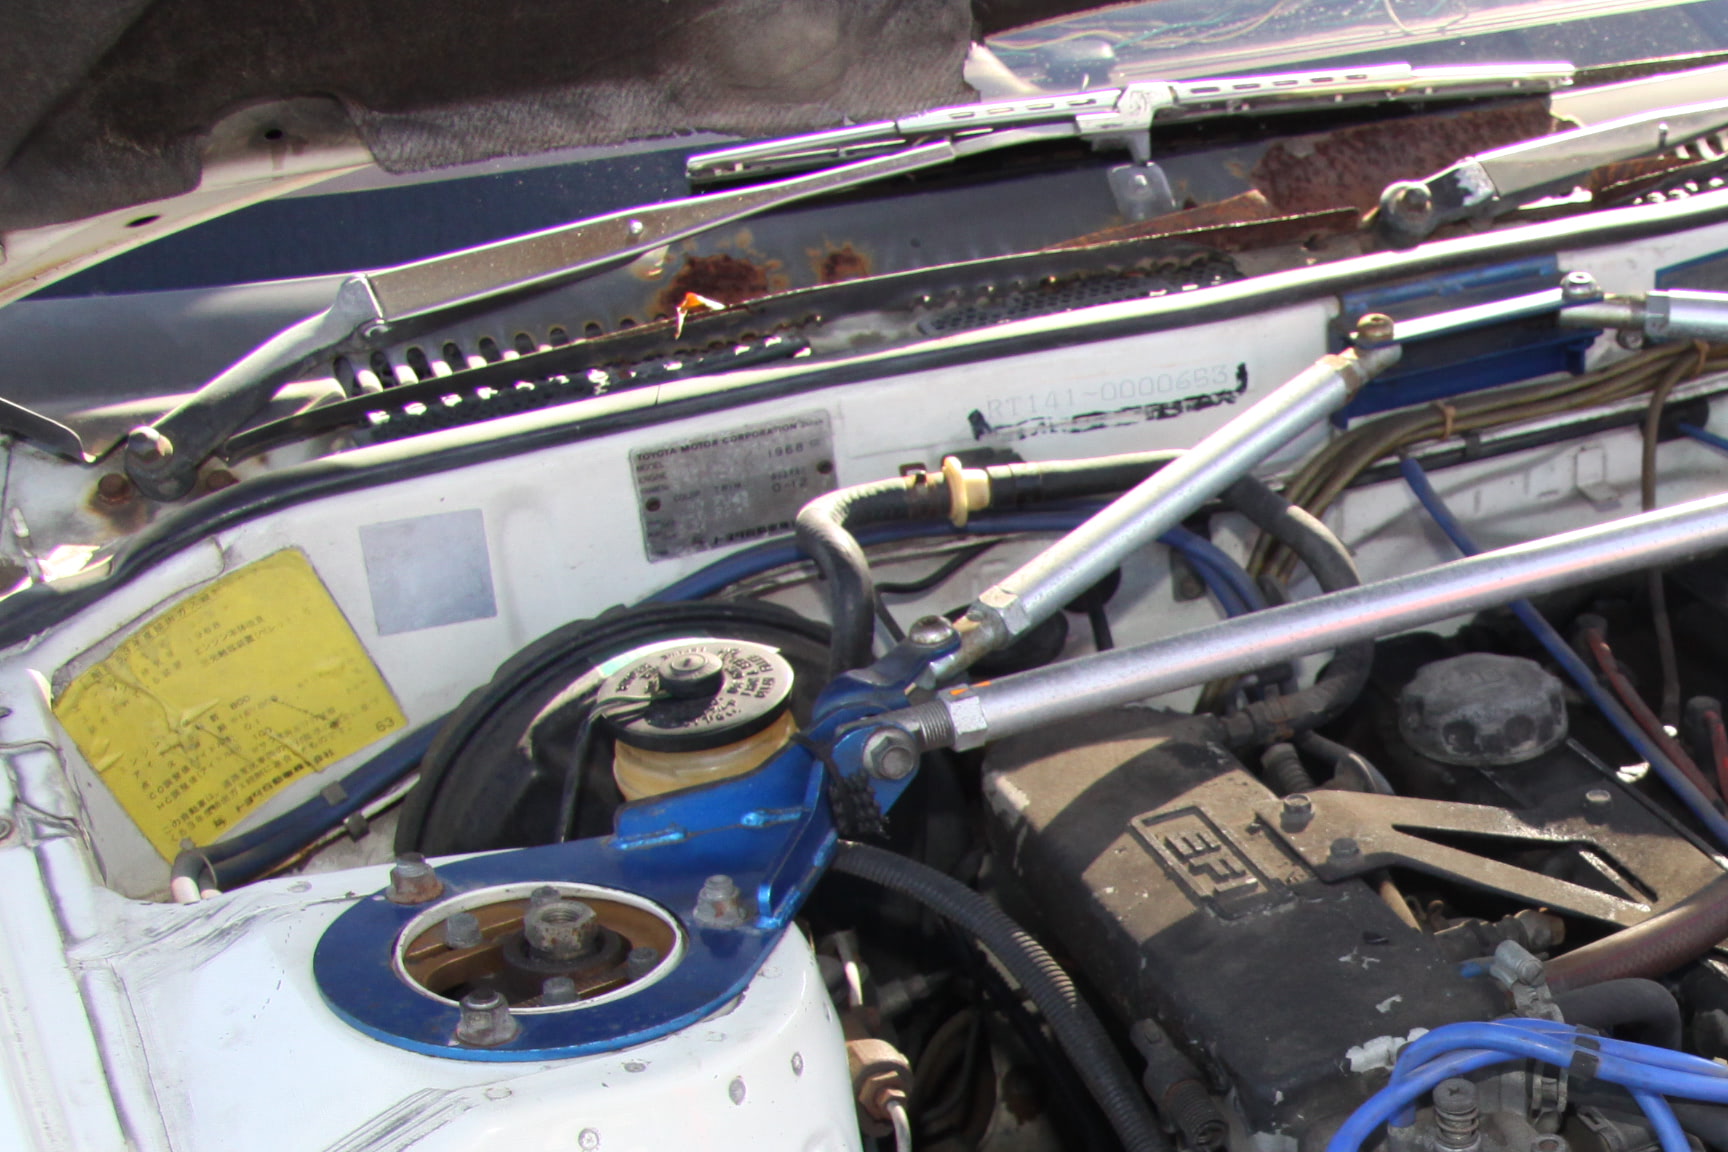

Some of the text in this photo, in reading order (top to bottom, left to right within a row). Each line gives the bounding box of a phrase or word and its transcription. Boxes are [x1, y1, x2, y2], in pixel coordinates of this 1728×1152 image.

[636, 447, 676, 461] TOYOTA
[680, 439, 718, 452] MOTOR
[721, 422, 797, 444] CORPORATION
[1161, 828, 1259, 895] EFI
